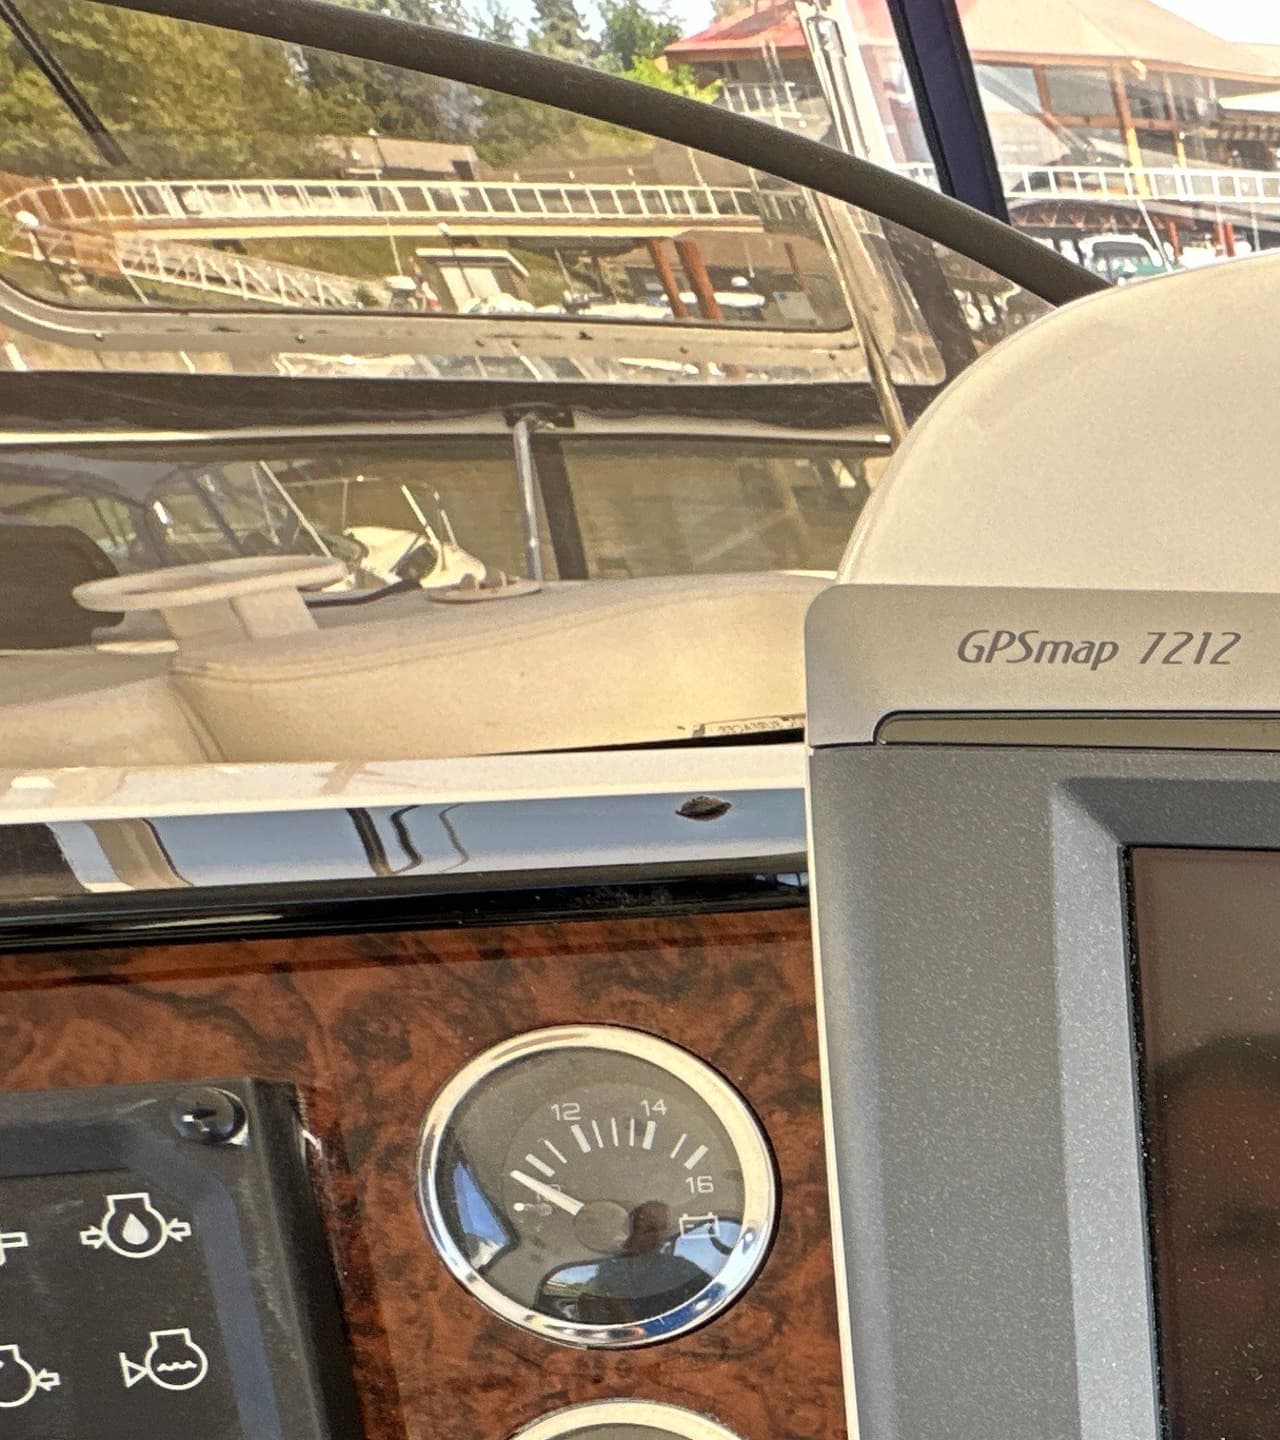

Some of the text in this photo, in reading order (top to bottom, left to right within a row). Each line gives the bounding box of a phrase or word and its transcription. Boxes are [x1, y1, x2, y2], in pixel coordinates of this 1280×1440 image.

[957, 629, 1242, 671] GPSmap 7212
[551, 1098, 668, 1121] 12 14
[685, 1175, 714, 1194] 16
